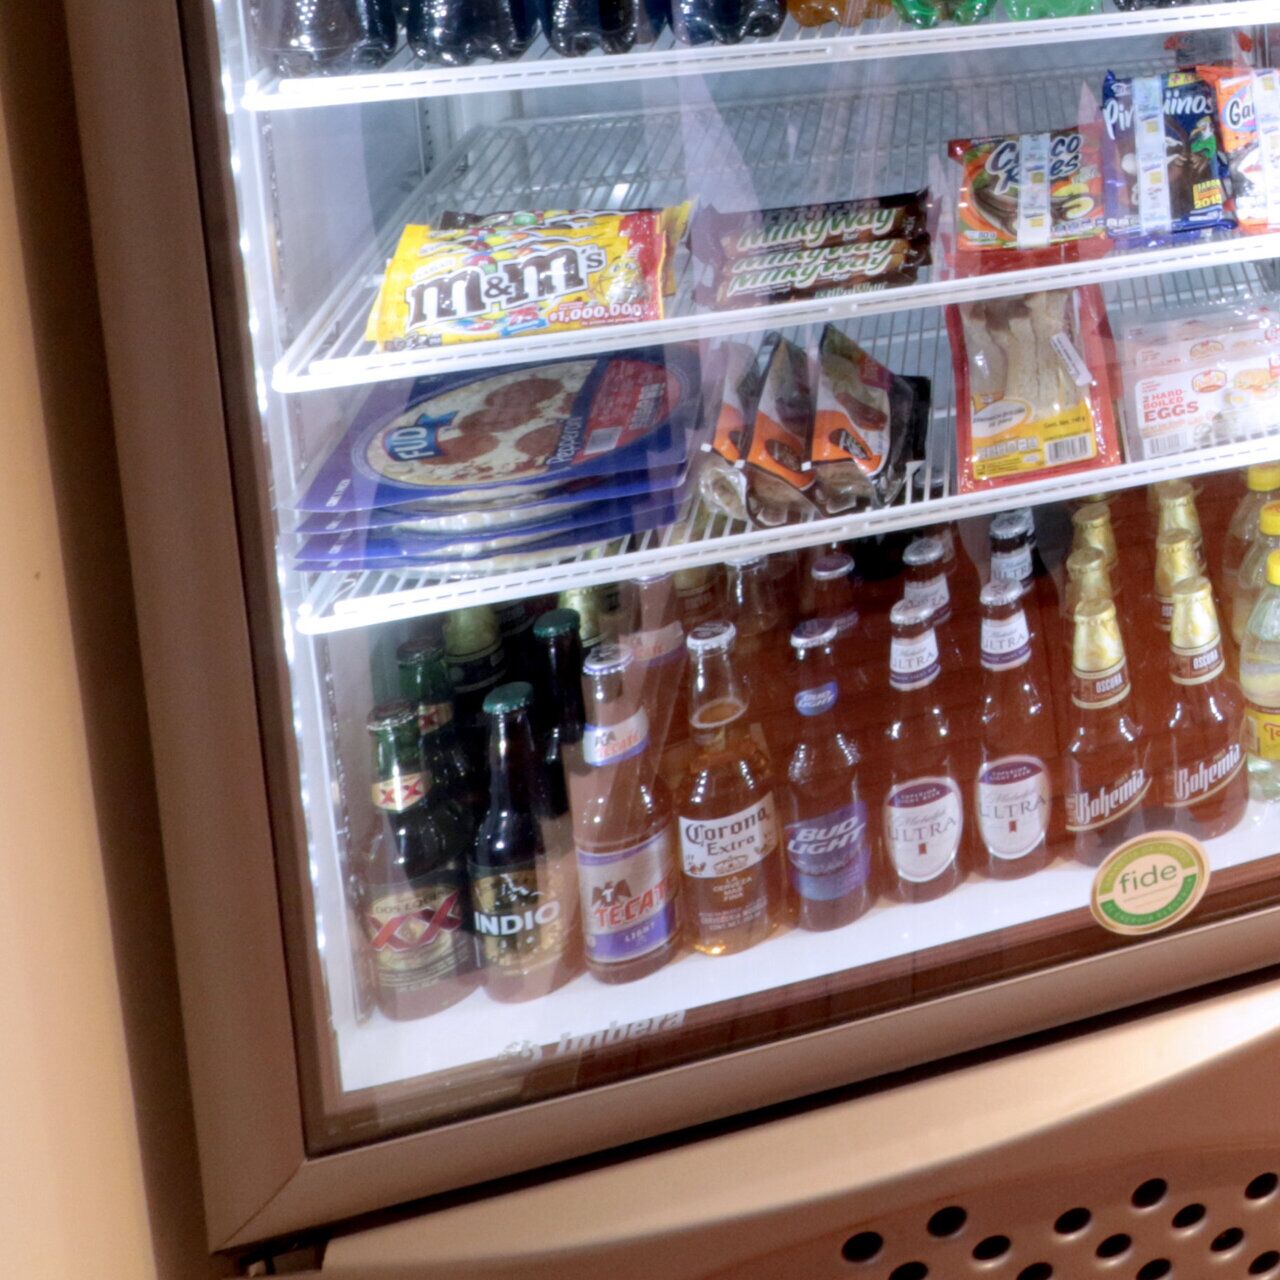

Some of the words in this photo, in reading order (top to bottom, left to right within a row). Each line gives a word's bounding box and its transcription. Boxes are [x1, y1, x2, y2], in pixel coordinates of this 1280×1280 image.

[1142, 397, 1184, 411] BOILED
[1143, 400, 1199, 423] EGGS
[397, 425, 435, 460] FUD
[1172, 743, 1241, 801] Bohemia
[1074, 768, 1145, 826] Bohemia
[685, 807, 767, 847] Corona
[786, 823, 867, 855] LIGHT
[796, 816, 860, 842] BUD
[706, 835, 756, 857] Extra
[1118, 864, 1178, 894] fide
[473, 899, 562, 937] INDIO
[623, 922, 658, 944] LIGHT
